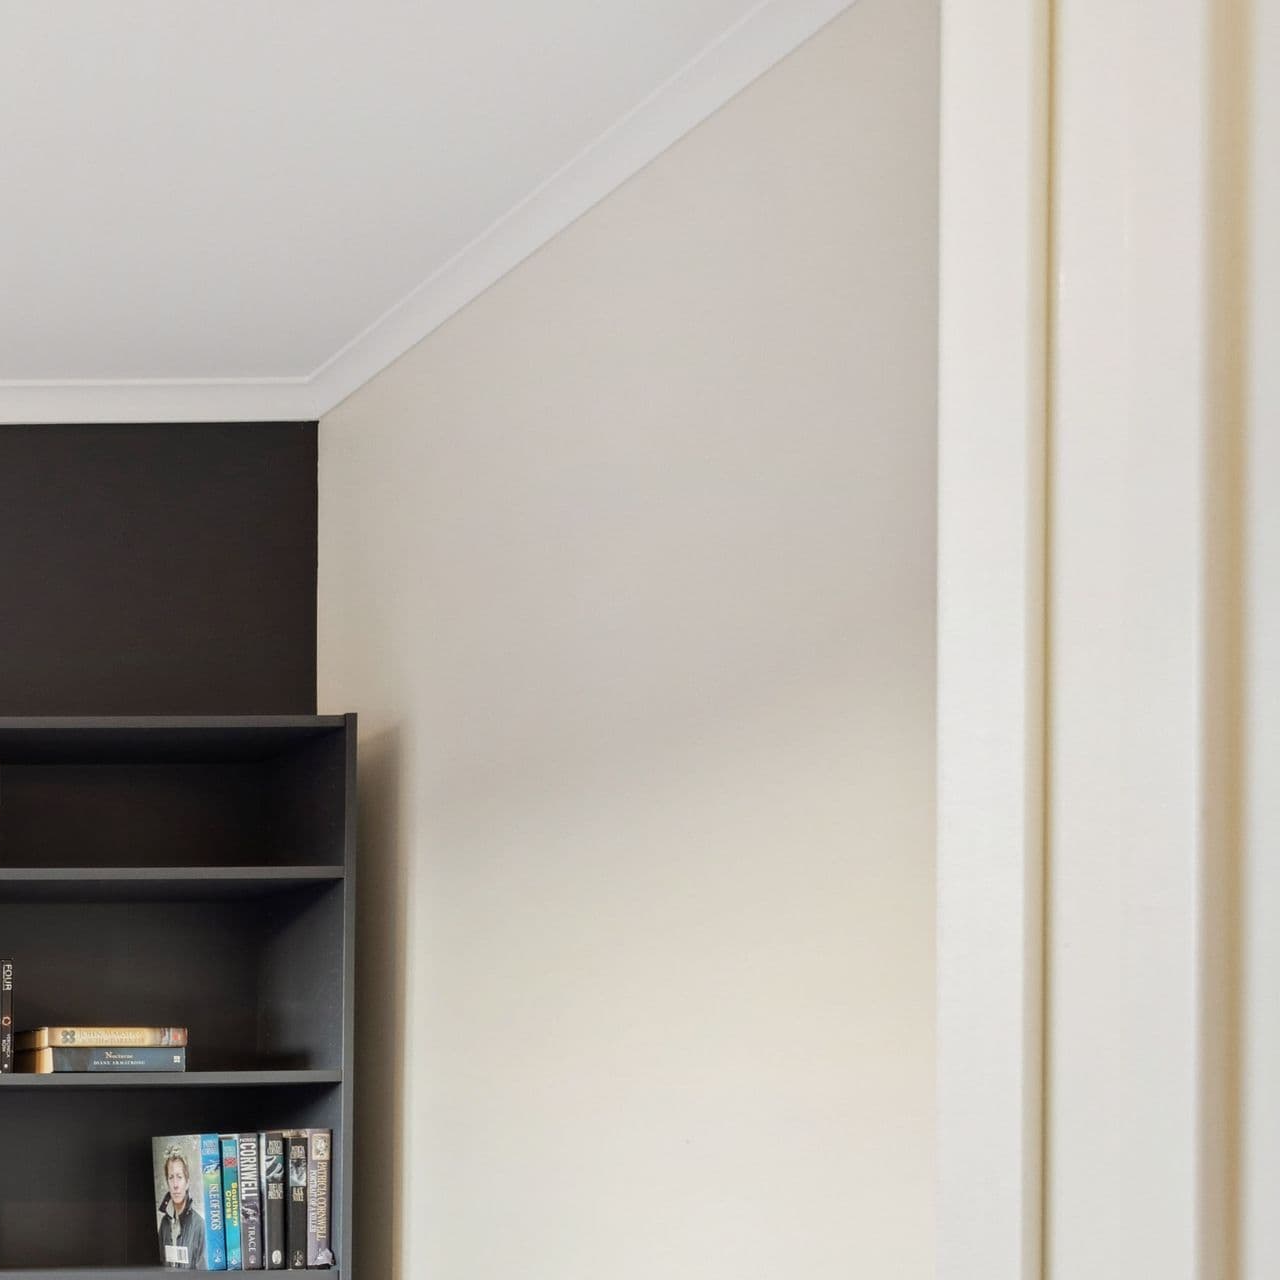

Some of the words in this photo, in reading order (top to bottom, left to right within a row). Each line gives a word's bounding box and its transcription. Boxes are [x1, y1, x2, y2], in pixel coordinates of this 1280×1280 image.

[240, 1142, 258, 1200] CORNWELL
[317, 1161, 327, 1196] PATRICIA
[210, 1184, 219, 1200] ISLE
[210, 1210, 220, 1230] DOGS
[316, 1196, 326, 1241] CORNWELL
[248, 1226, 256, 1252] TRACE
